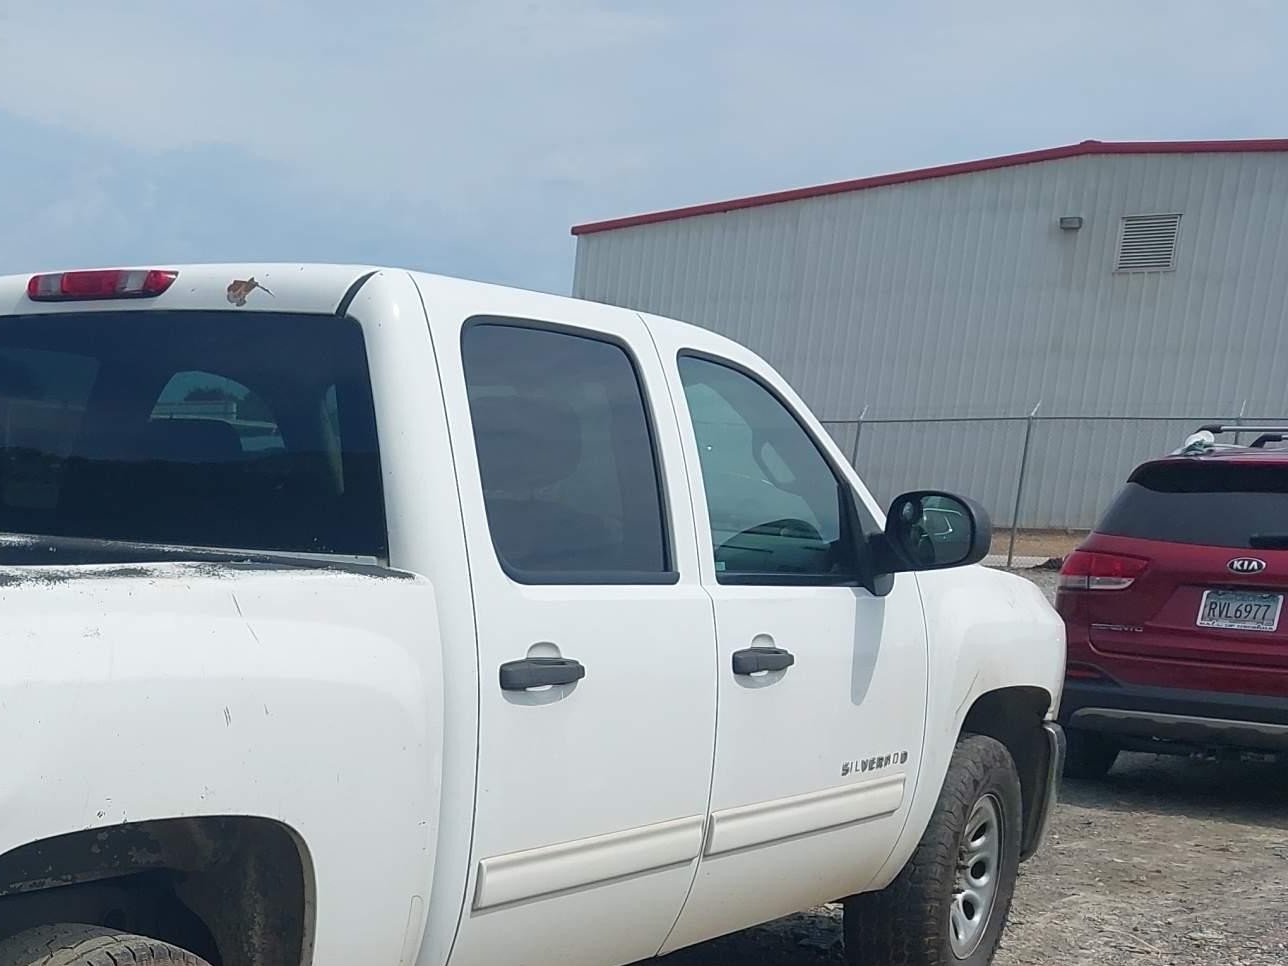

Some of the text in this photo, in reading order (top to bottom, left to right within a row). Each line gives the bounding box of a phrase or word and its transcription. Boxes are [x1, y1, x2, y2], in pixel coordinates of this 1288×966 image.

[1232, 560, 1258, 571] KIA
[1207, 601, 1272, 621] RVL6977
[841, 750, 909, 777] SILVERADO
